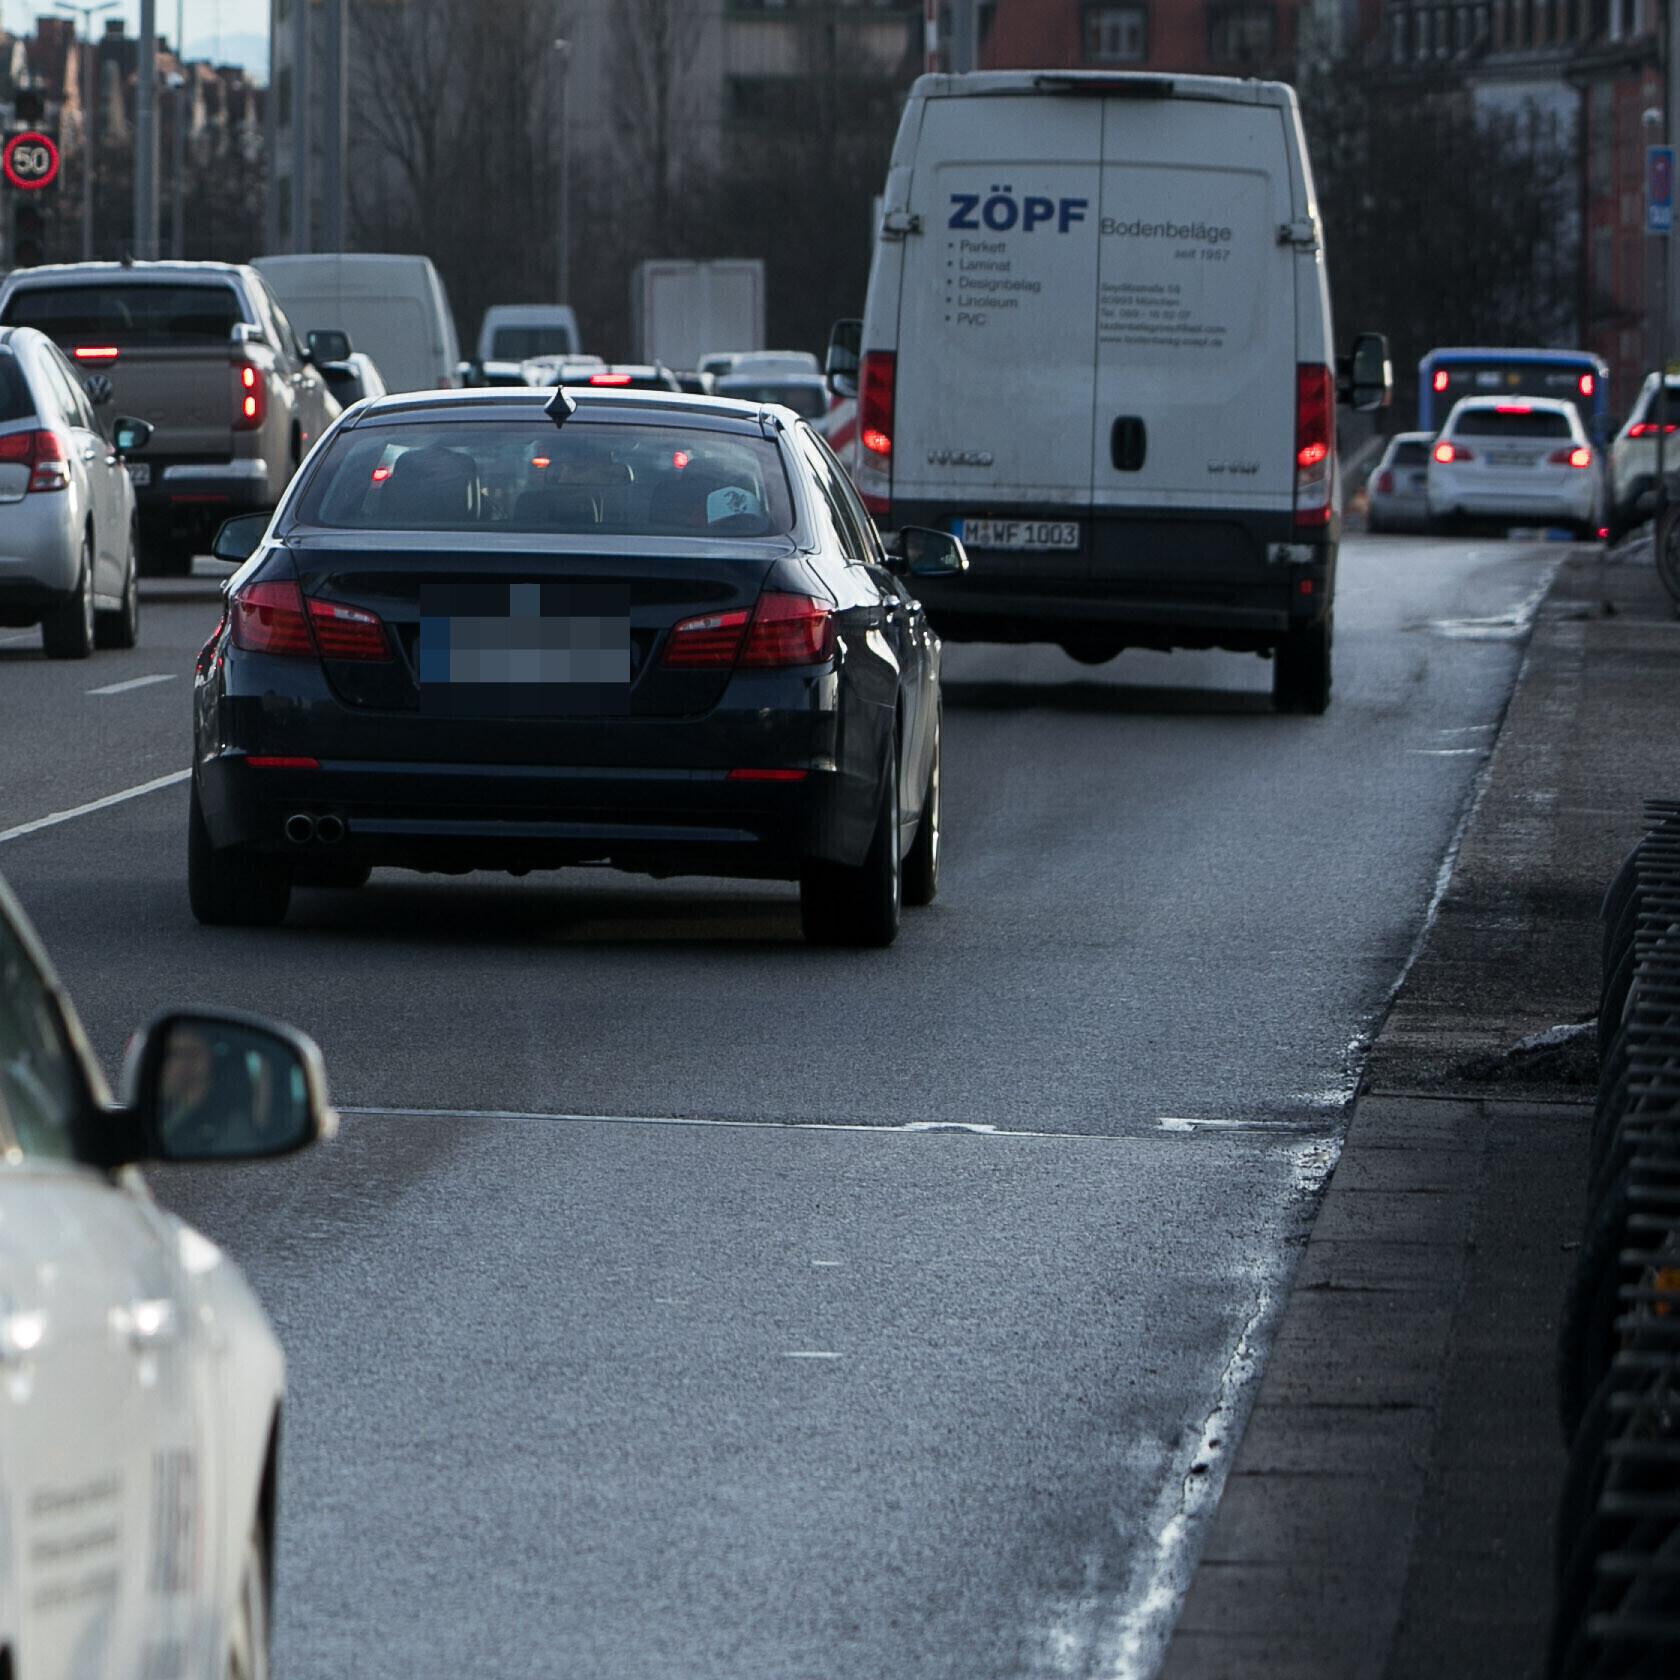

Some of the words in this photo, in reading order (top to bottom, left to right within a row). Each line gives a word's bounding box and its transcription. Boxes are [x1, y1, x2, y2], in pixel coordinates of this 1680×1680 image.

[13, 147, 49, 174] 50
[948, 185, 1088, 234] ZÖPF
[959, 239, 1006, 253] Parkett
[959, 257, 1011, 272] Laminat
[959, 275, 1041, 293] Designbelag
[957, 294, 1018, 309] Linoleum
[957, 312, 987, 326] PVC
[965, 521, 978, 542] M
[993, 522, 1019, 543] WF
[1024, 524, 1076, 545] 1003
